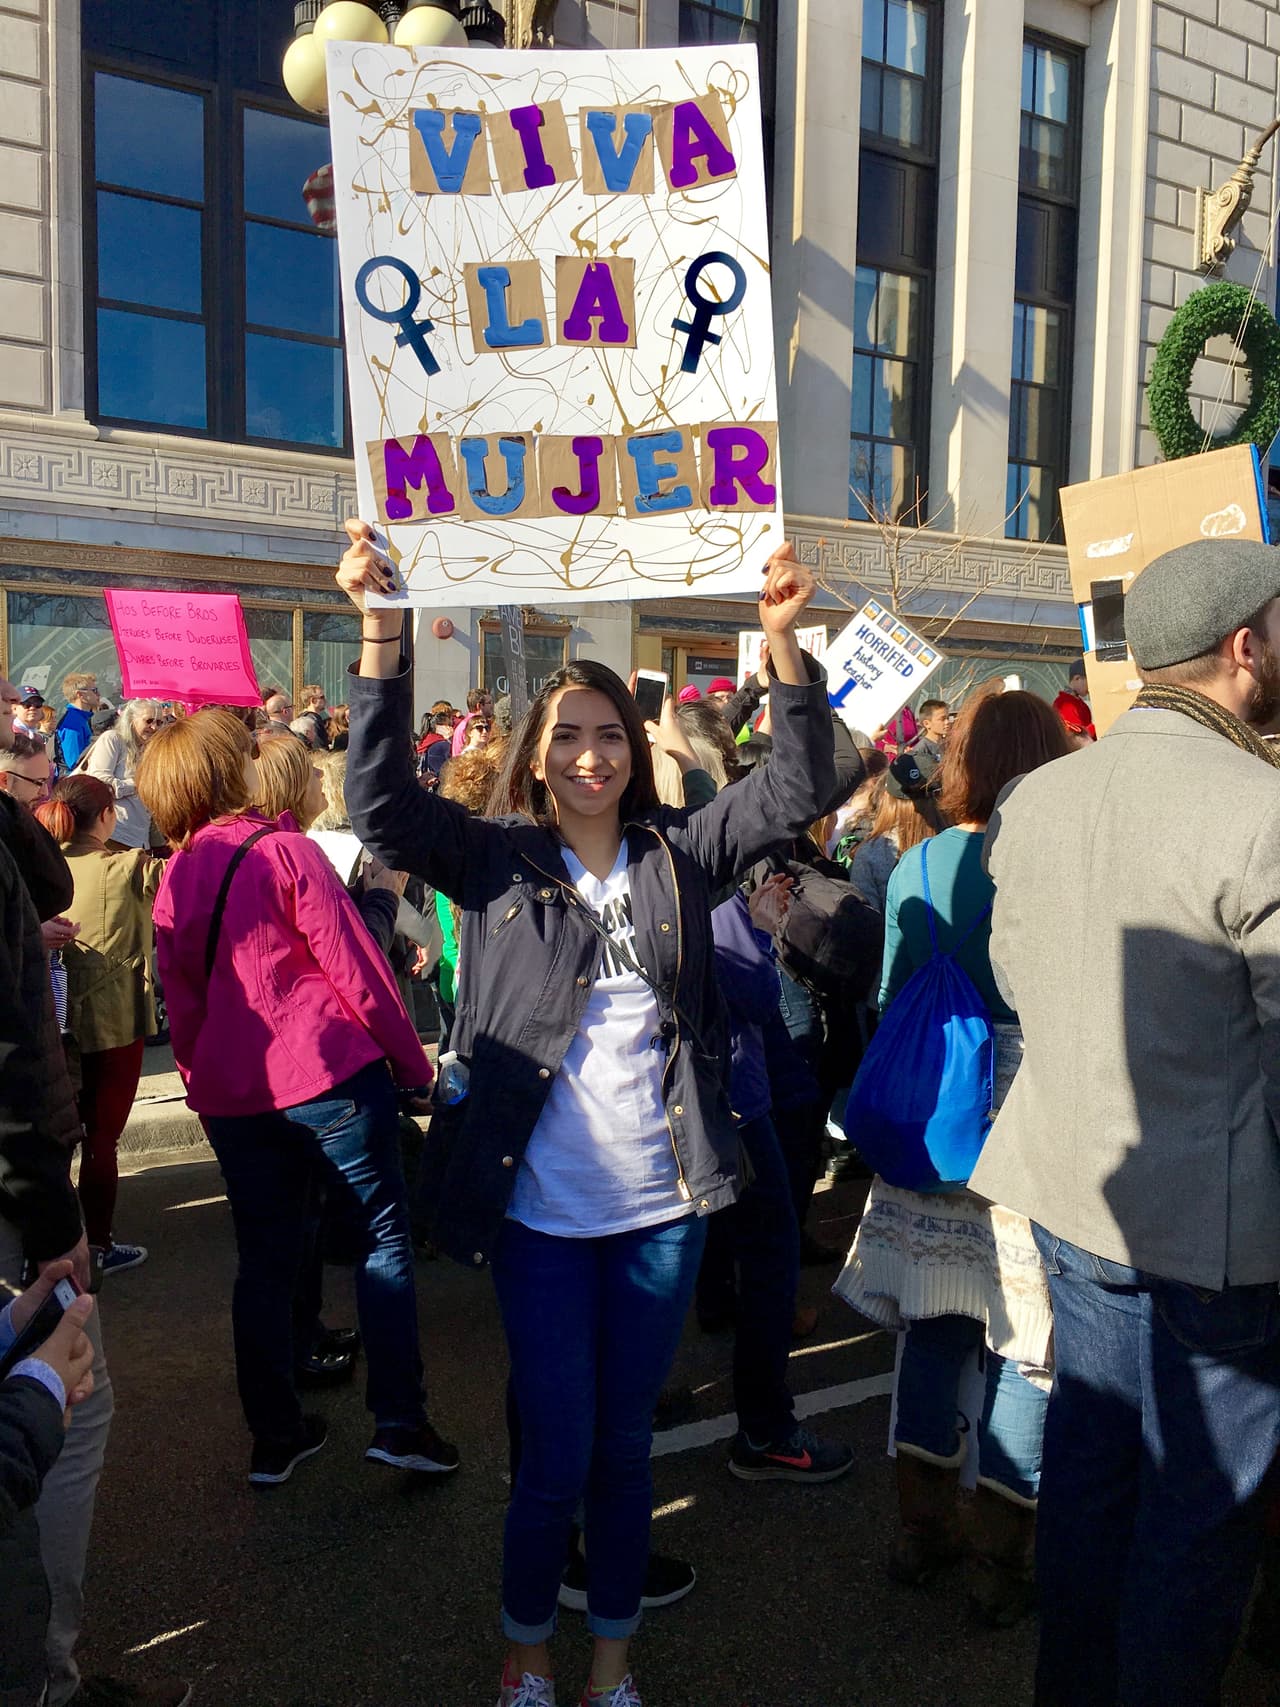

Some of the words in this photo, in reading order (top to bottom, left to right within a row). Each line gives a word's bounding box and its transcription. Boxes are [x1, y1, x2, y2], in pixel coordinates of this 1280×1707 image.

[414, 101, 737, 193] VIVA
[477, 262, 630, 348] LA
[383, 426, 777, 520] MUJER
[140, 600, 182, 619] BEFORE
[187, 602, 218, 622] BROS
[155, 628, 182, 642] BEFORE
[855, 624, 914, 677] HORRIFIED
[157, 654, 184, 668] BEFORE
[190, 656, 241, 672] BROVARIES
[842, 659, 873, 690] teacher
[852, 645, 883, 681] history
